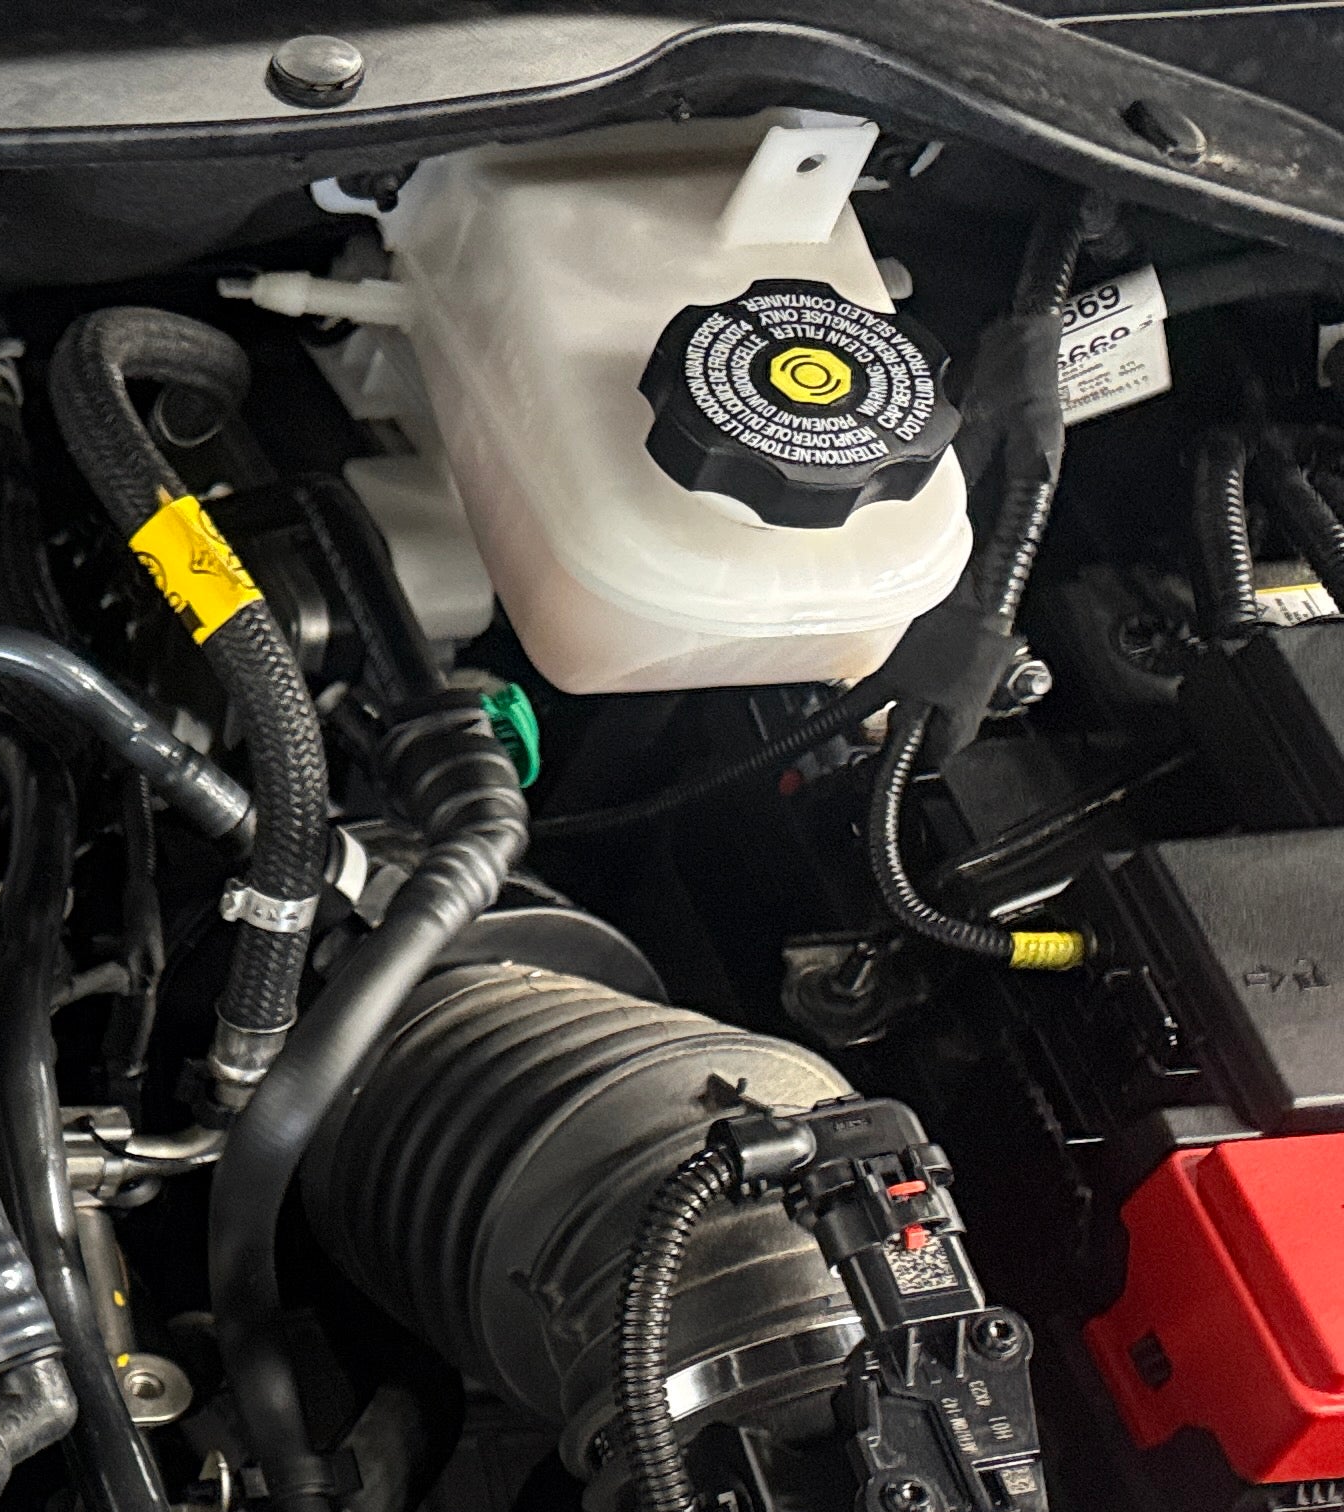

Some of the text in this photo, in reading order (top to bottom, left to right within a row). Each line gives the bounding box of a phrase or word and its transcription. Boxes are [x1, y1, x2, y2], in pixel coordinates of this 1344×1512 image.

[759, 308, 798, 327] ONLY
[800, 309, 832, 327] USE
[837, 303, 896, 338] SEALED
[731, 334, 769, 368] SCELLE
[890, 333, 909, 344] A
[685, 346, 707, 378] AVANT
[707, 339, 733, 369] FREIN
[896, 342, 930, 376] FROM
[707, 367, 728, 383] DE
[731, 367, 757, 397] BIDON
[769, 324, 889, 417] WARNING: CLEAN FILLER
[887, 363, 911, 408] BEFORE
[686, 378, 731, 425] BOUCHON
[711, 382, 751, 420] LIQUIDE
[913, 377, 934, 412] FLUID
[719, 419, 744, 437] LE
[742, 413, 767, 430] DU
[772, 411, 858, 431] PROVENANT
[877, 404, 904, 429] CAP
[738, 429, 811, 463] NETTOYER
[760, 422, 792, 442] QUE
